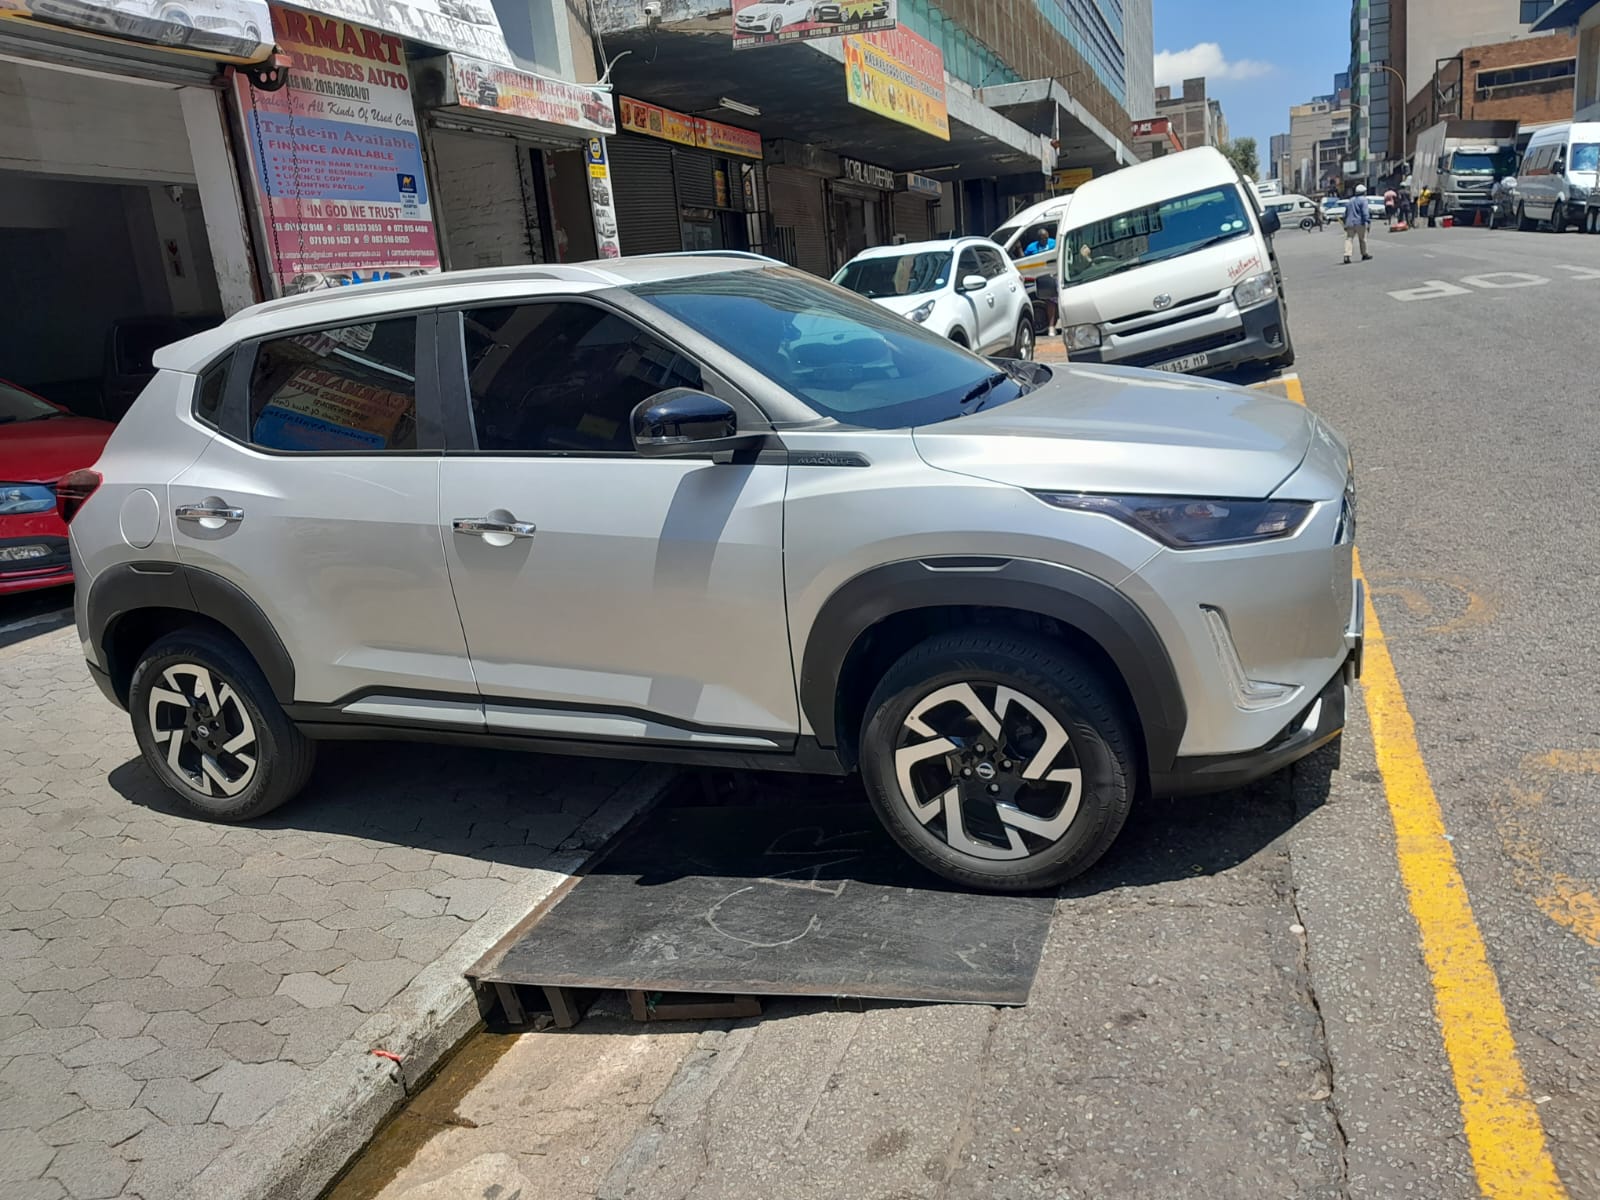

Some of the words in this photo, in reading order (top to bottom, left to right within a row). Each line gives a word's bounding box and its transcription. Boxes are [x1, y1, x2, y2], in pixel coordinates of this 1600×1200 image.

[424, 12, 450, 35] 083
[270, 8, 402, 65] ARMART
[290, 51, 365, 83] RPRISES
[367, 66, 409, 90] AUTO
[459, 69, 478, 90] 168
[301, 76, 315, 92] NO:
[314, 79, 371, 101] 2016/39024/07
[293, 96, 305, 110] In
[307, 99, 326, 113] All
[327, 102, 355, 118] Kinds
[357, 108, 369, 122] Of
[370, 109, 393, 123] Used
[395, 112, 415, 126] Cars
[260, 119, 338, 141] Trade-in
[343, 130, 415, 150] Available
[268, 139, 327, 154] FINANCE
[330, 145, 395, 161] AVAILABLE
[281, 165, 312, 173] PROOF
[328, 168, 373, 177] RESIDENCE
[288, 157, 326, 167] MONTHS
[328, 160, 352, 168] BANK
[353, 162, 400, 172] STATEMENT
[293, 181, 330, 189] MONTHS
[332, 183, 365, 191] PAYSLIP
[325, 204, 348, 217] GOD
[350, 205, 366, 218] WE
[1193, 354, 1206, 367] MP
